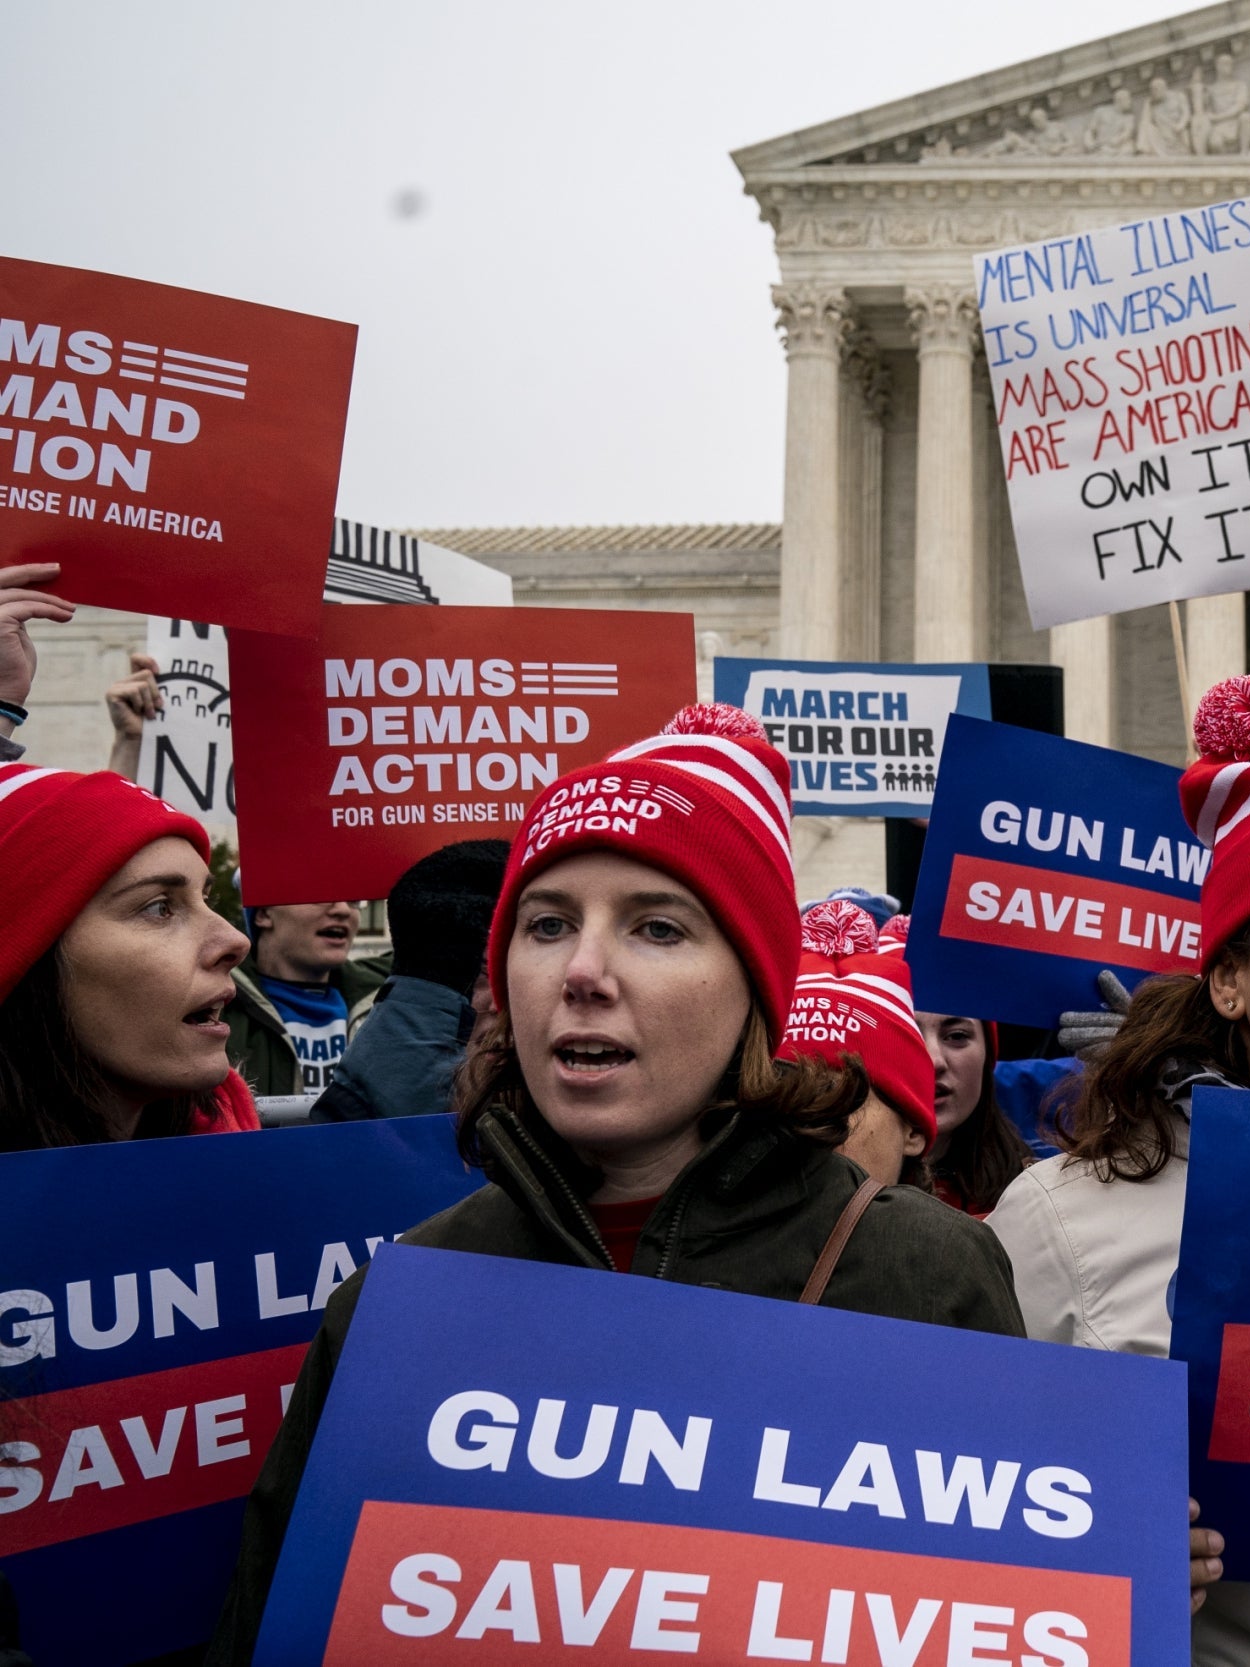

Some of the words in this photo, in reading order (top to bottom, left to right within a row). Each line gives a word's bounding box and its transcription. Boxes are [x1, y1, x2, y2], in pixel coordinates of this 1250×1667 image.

[978, 235, 1114, 310] MENTAL
[0, 318, 113, 375] MS
[985, 321, 1037, 367] IS
[1049, 272, 1236, 351] UNIVERSAL
[0, 374, 200, 444] MAND
[998, 357, 1108, 424] MASS
[0, 428, 151, 493] ION
[1007, 420, 1069, 480] ARE
[1081, 455, 1171, 509] OWN
[0, 485, 62, 514] ENSE
[69, 496, 96, 520] IN
[104, 502, 223, 542] AMERICA
[1092, 516, 1182, 580] FIX
[325, 658, 516, 697] MOMS
[761, 687, 909, 721] MARCH
[327, 706, 590, 746] DEMAND
[763, 723, 844, 755] FOR
[851, 726, 935, 757] OUR
[154, 735, 236, 816] N
[329, 752, 558, 795] ACTION
[791, 760, 878, 791] IVES
[332, 807, 374, 827] FOR
[382, 804, 425, 825] GUN
[433, 803, 498, 823] SENSE
[505, 802, 525, 821] IN
[521, 815, 638, 866] ACTION
[527, 797, 662, 841] DEMAND
[980, 800, 1105, 862] GUN
[1120, 827, 1213, 886] LAW
[965, 881, 1105, 939] SAVE
[1118, 907, 1202, 960] LIVE
[787, 1011, 861, 1033] MAND
[791, 997, 831, 1010] MS
[291, 1033, 346, 1062] MAR
[782, 1026, 846, 1044] TION
[303, 1062, 339, 1088] OR
[0, 1261, 219, 1368] GUN
[255, 1234, 404, 1320] LA
[0, 1394, 251, 1515] SAVE
[426, 1390, 713, 1492] GUN
[752, 1426, 1094, 1539] LAWS
[380, 1552, 710, 1654] SAVE
[746, 1579, 1089, 1667] LIVES
